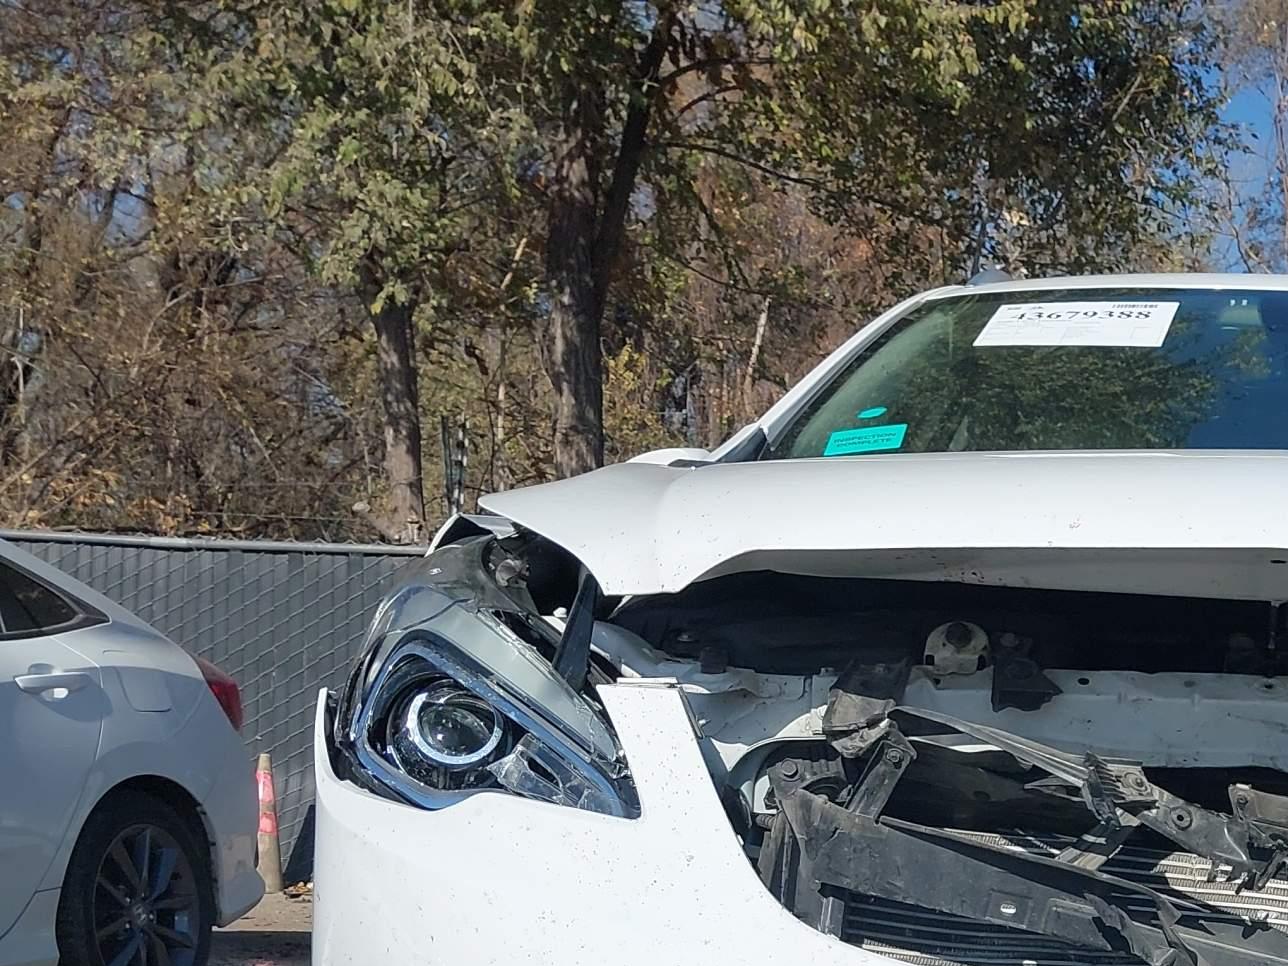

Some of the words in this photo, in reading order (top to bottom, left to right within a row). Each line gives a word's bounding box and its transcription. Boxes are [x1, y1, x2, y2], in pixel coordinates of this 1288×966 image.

[1011, 309, 1152, 321] 43679388
[833, 432, 897, 444] INSPECTION
[836, 438, 892, 448] COMPLETE
